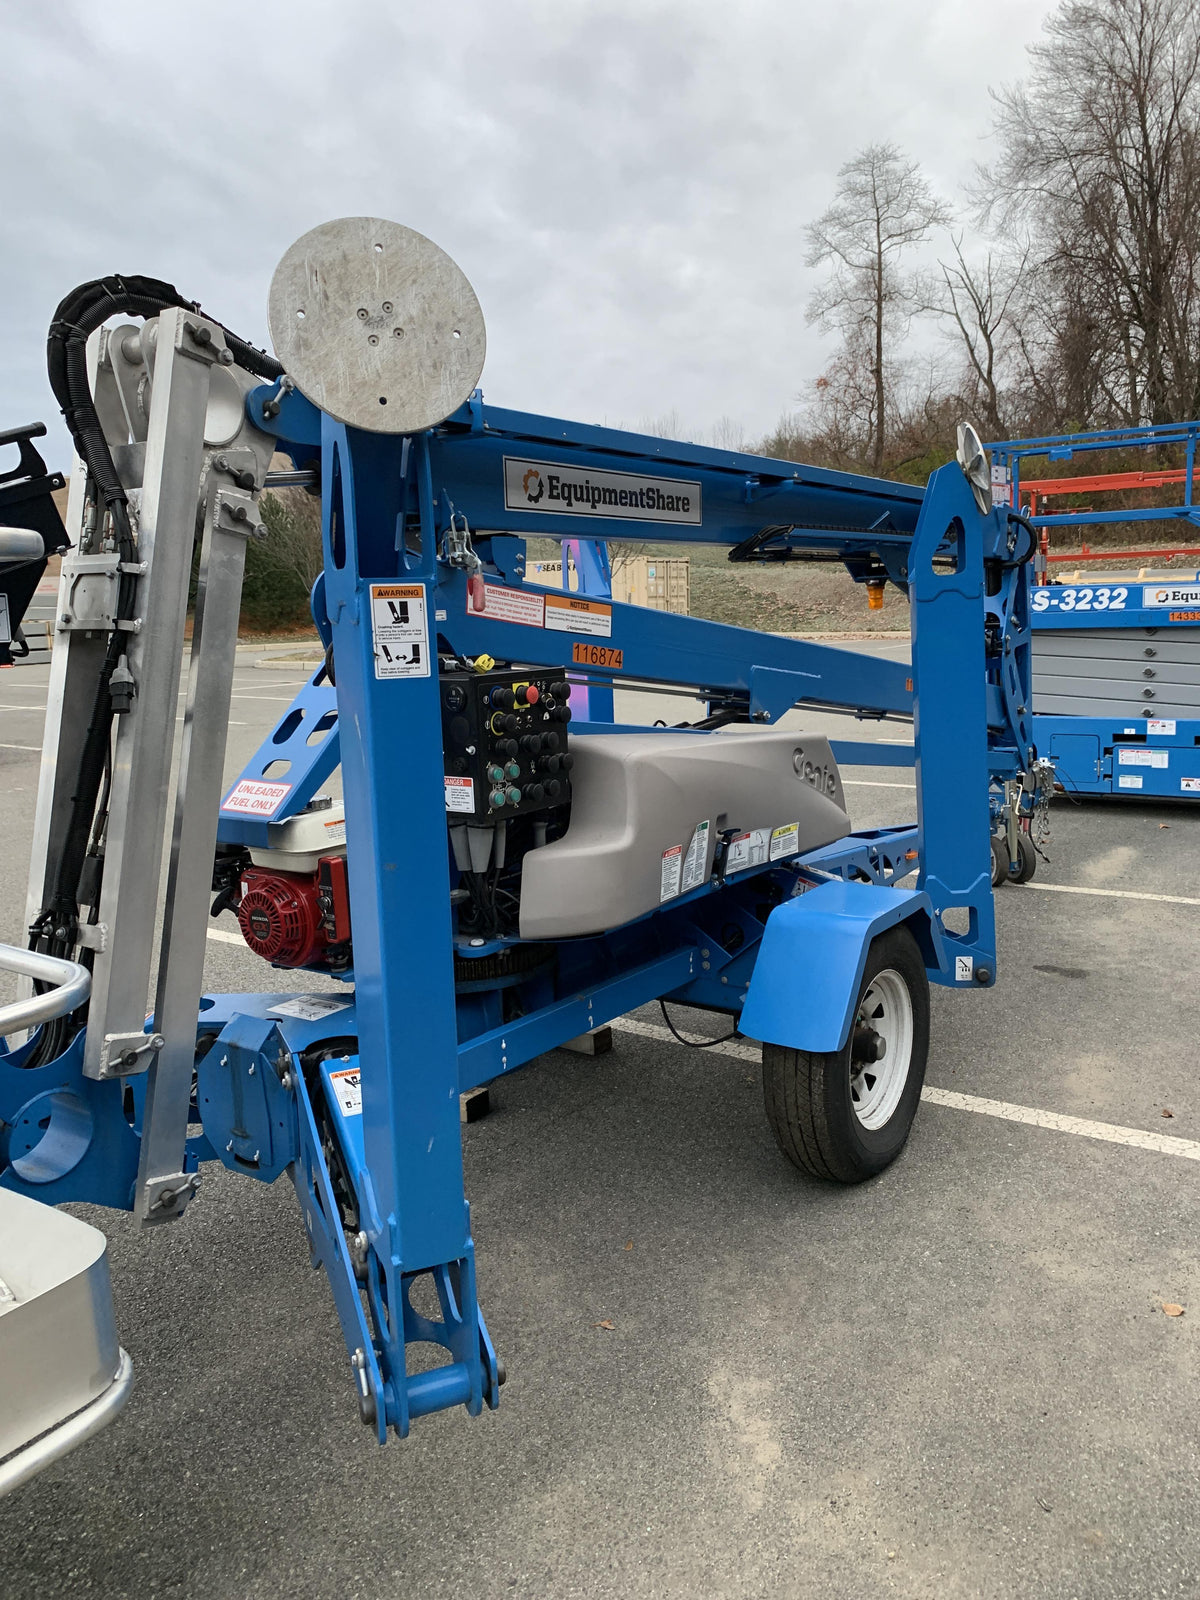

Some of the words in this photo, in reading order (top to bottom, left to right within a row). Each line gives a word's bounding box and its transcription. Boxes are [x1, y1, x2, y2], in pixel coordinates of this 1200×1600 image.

[547, 474, 690, 513] EquipmentShare
[542, 564, 556, 573] SEA
[383, 589, 419, 597] WARNING
[486, 588, 510, 598] CUSTOMER
[1030, 587, 1128, 612] S-3232
[570, 601, 590, 611] NOTICE
[574, 643, 622, 668] 116874
[793, 747, 836, 799] Genie
[237, 785, 284, 798] UNLEADED
[228, 796, 249, 807] FUEL
[251, 799, 276, 810] ONLY
